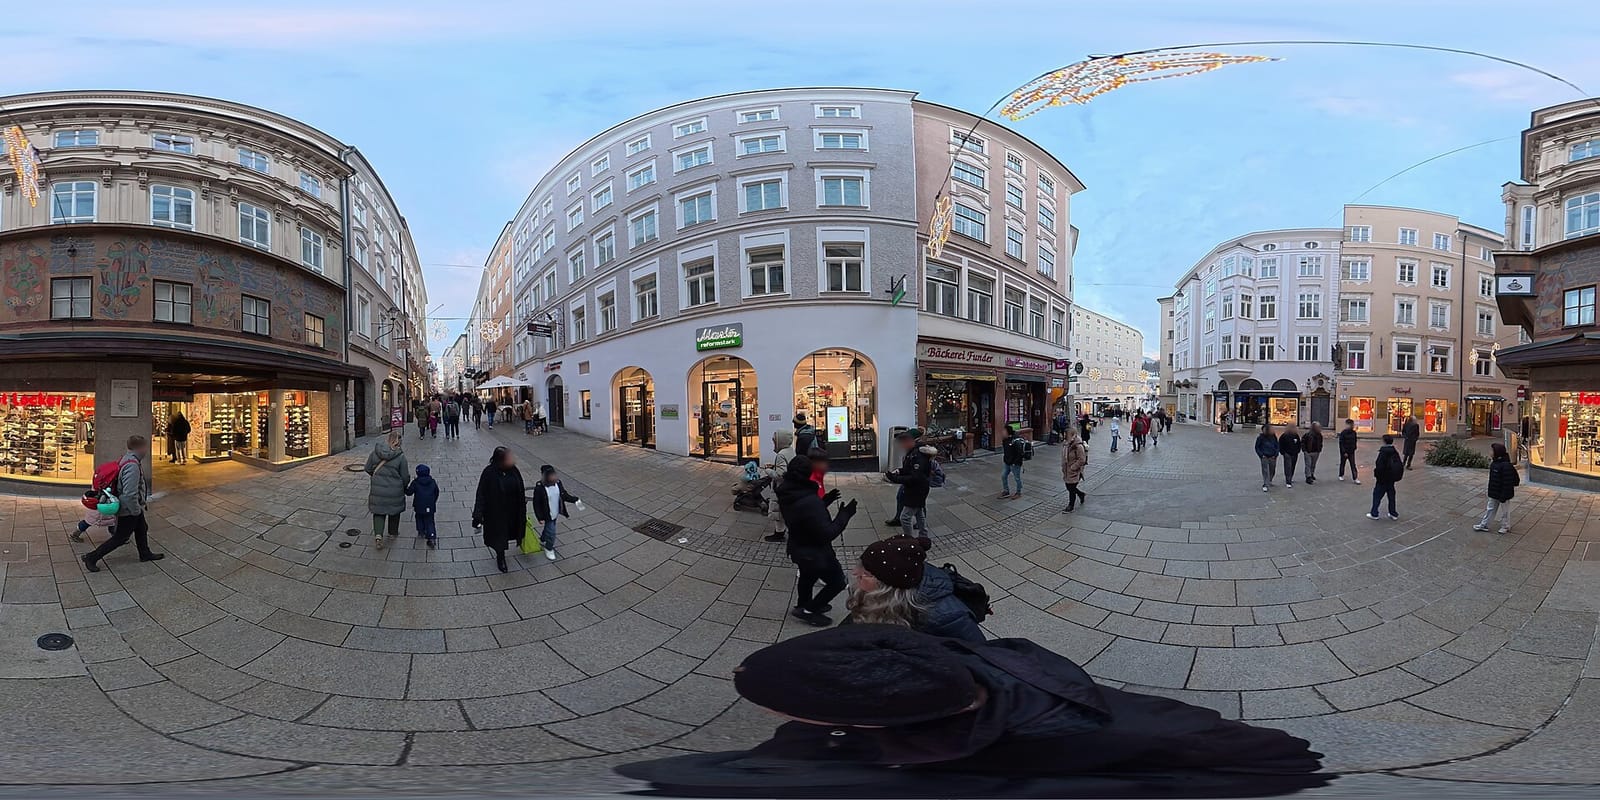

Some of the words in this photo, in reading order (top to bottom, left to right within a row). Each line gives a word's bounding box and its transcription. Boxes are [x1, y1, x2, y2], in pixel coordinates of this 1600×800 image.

[701, 339, 735, 348] reformstark
[927, 347, 966, 360] Bäckerei
[966, 351, 993, 363] Funder
[12, 392, 63, 407] Locker
